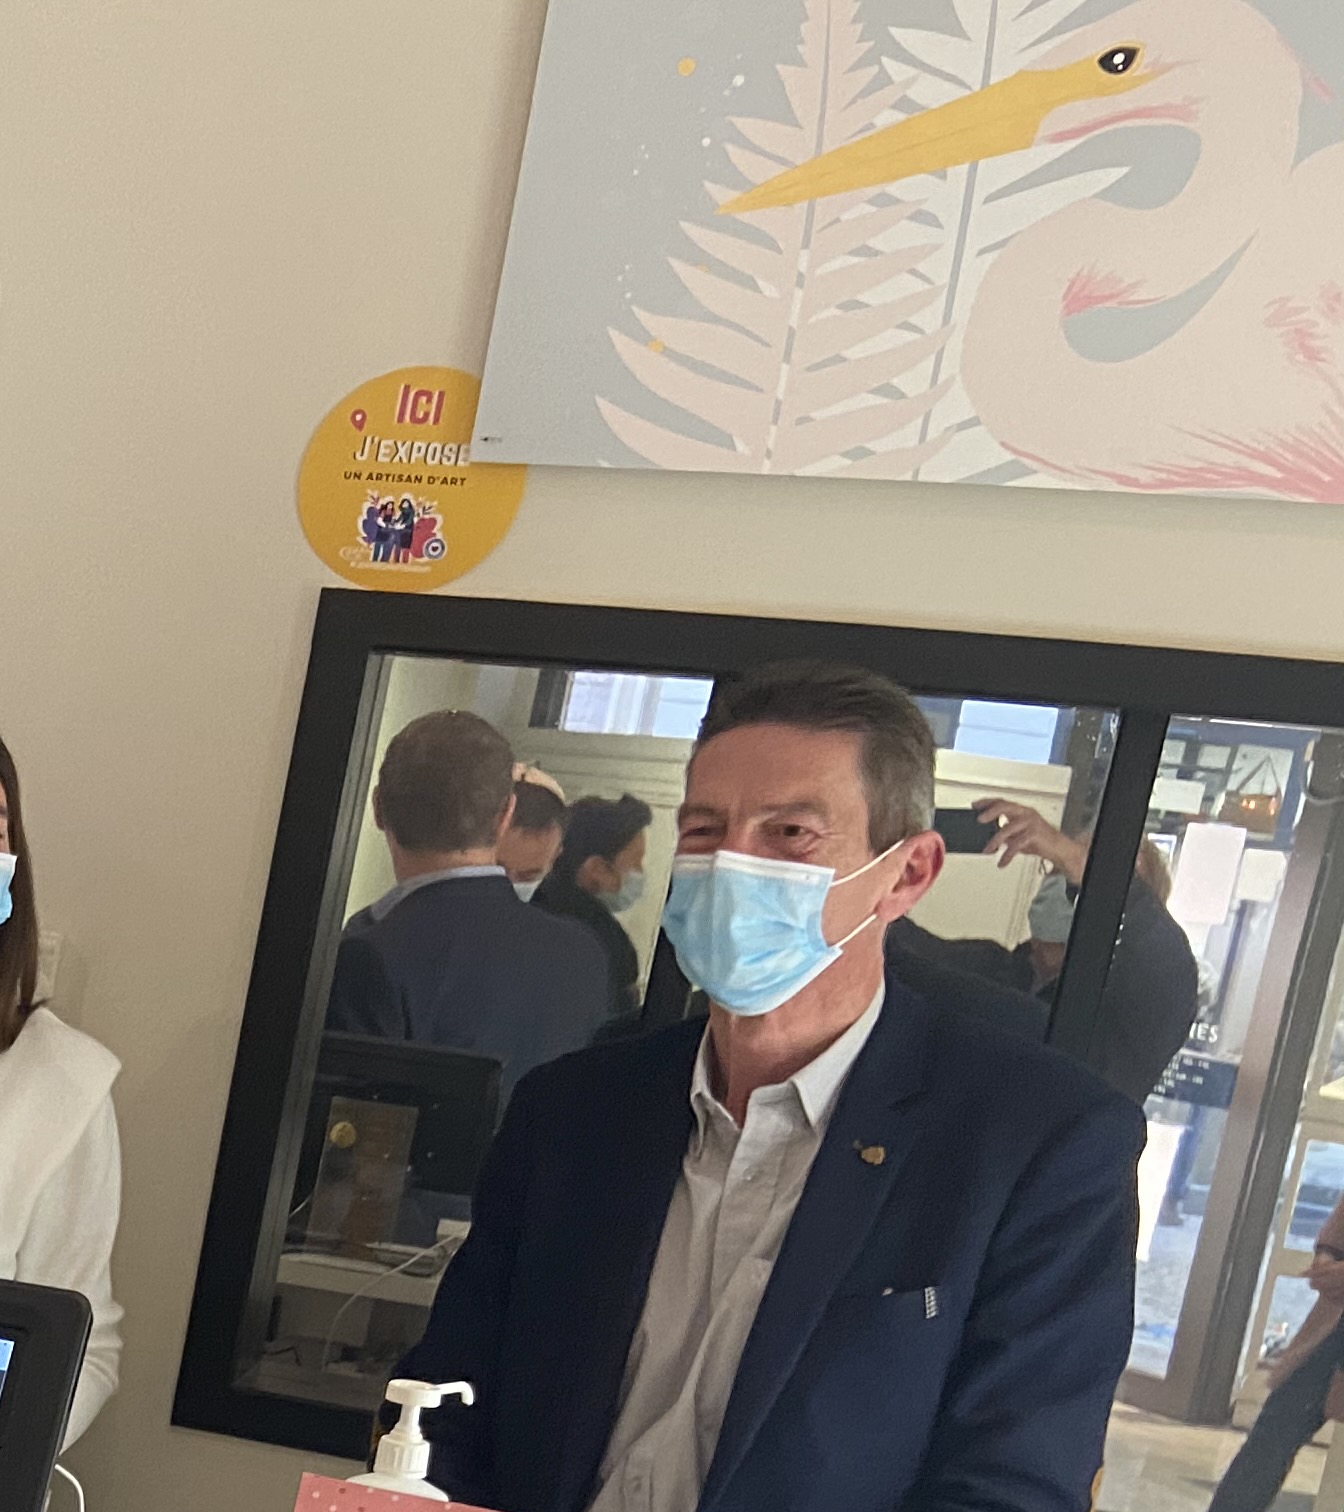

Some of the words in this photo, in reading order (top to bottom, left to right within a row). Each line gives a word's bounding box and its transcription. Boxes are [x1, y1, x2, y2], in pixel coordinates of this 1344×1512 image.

[394, 383, 446, 425] ICI
[343, 471, 363, 481] UN
[365, 472, 423, 484] ARTISAN
[427, 475, 467, 486] D'ART
